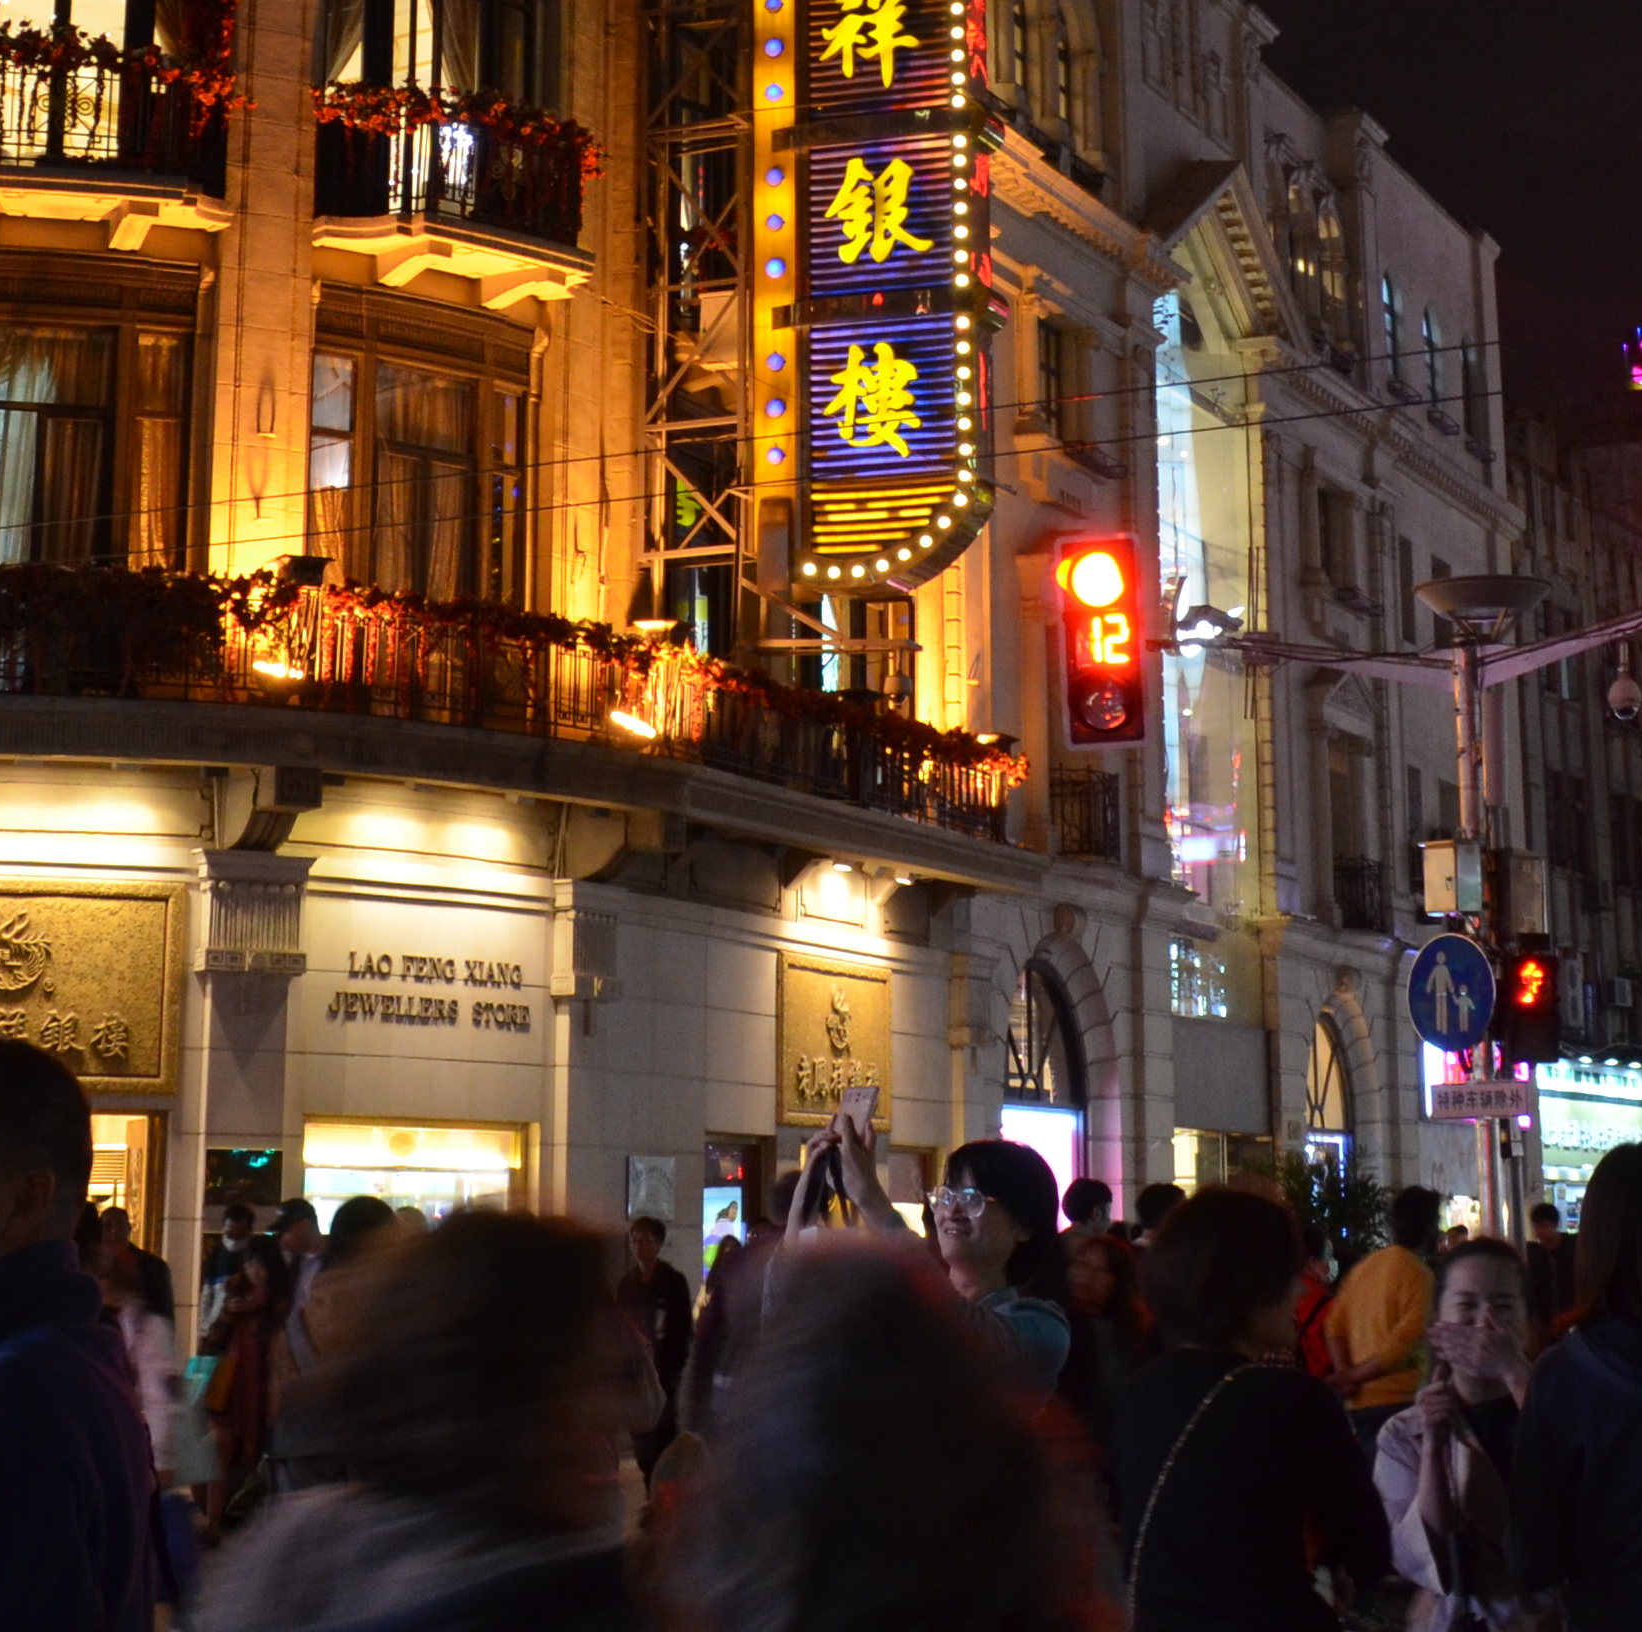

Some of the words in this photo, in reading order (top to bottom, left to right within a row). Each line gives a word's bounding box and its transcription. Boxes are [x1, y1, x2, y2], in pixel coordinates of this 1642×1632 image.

[1088, 613, 1130, 665] 12
[348, 951, 393, 979] LAO
[401, 954, 455, 983] FENG
[464, 959, 523, 988] XIANG
[328, 991, 459, 1023] JEWELLERS
[472, 1001, 531, 1029] STORE
[1437, 1088, 1524, 1111] 特种车辆除外
